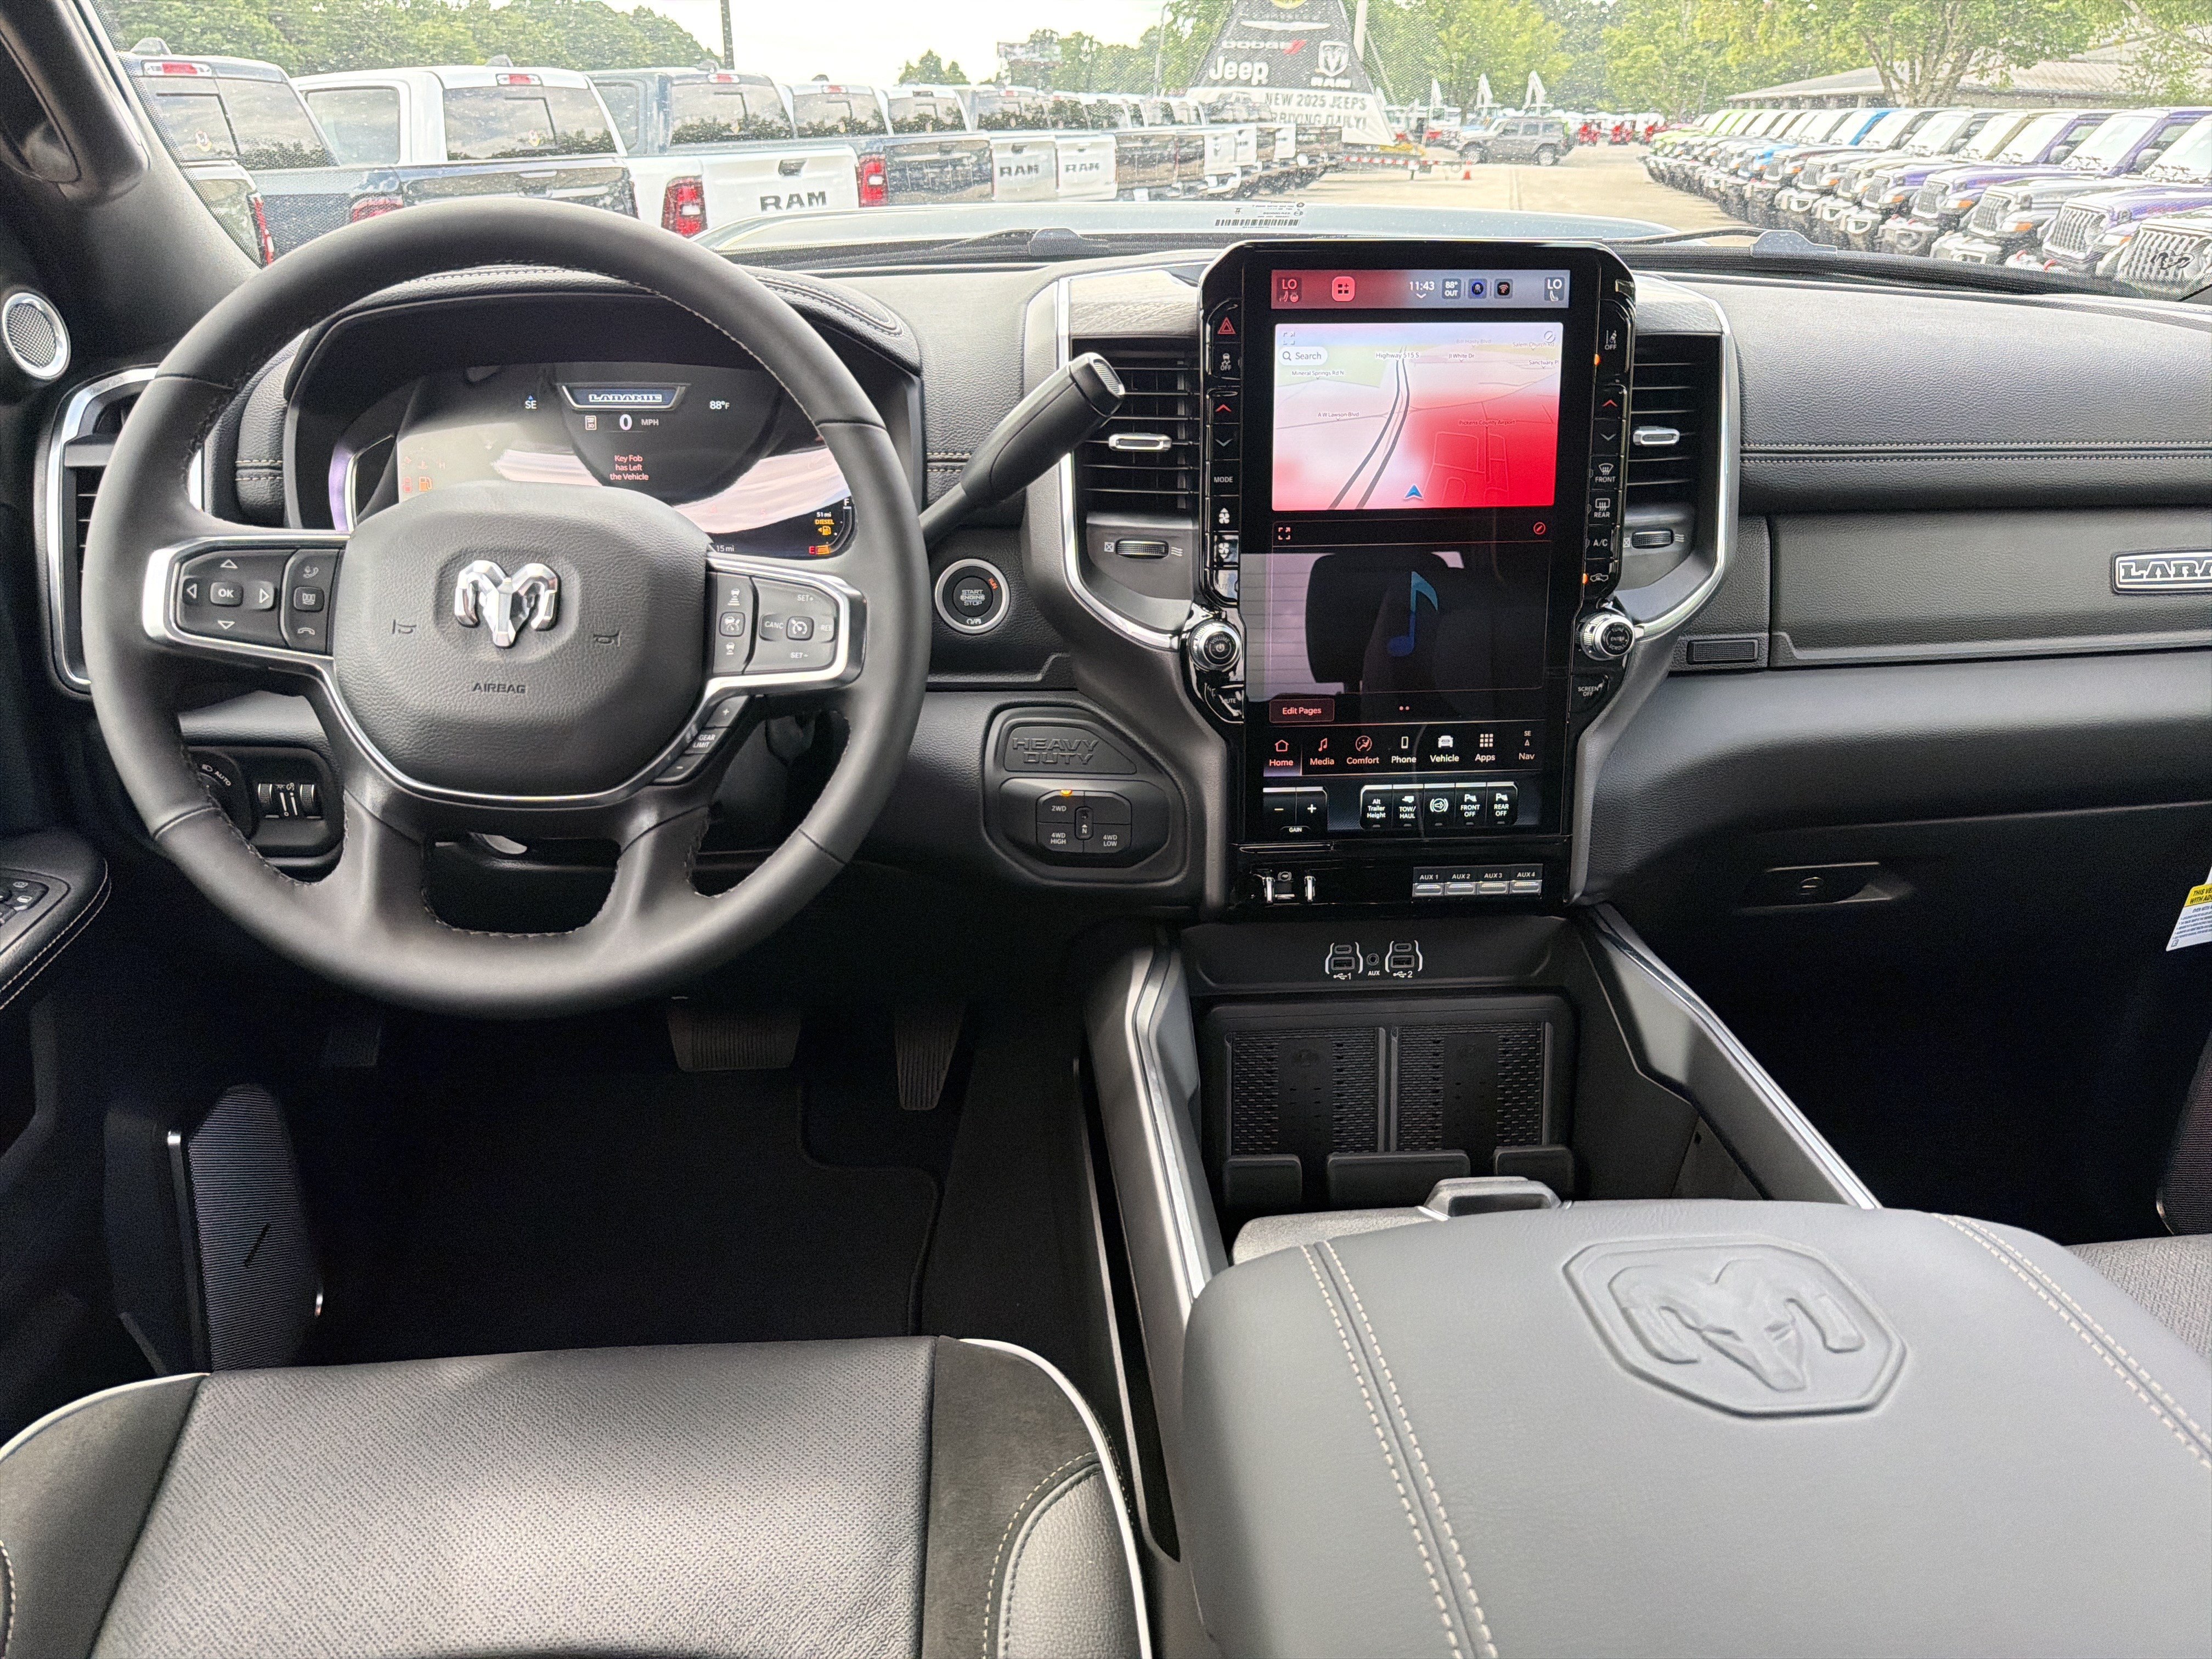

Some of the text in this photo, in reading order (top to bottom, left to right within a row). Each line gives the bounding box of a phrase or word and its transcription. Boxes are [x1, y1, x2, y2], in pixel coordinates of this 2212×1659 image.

[1209, 55, 1269, 85] Jeep
[1265, 92, 1367, 111] NEW 2025 JEEPS
[999, 164, 1040, 177] RAM
[1065, 162, 1099, 173] RAM
[759, 190, 827, 213] RAM
[1282, 279, 1297, 290] LO
[1409, 281, 1435, 291] 11:43
[1547, 279, 1562, 290] LO
[589, 394, 662, 403] LARAMIE
[524, 400, 537, 409] SE
[619, 414, 633, 430] 0
[614, 455, 628, 463] Key
[218, 589, 234, 598] OK
[765, 621, 784, 630] CANC
[472, 682, 526, 693] AIRBAG
[1299, 707, 1322, 716] Pages
[1013, 737, 1099, 752] HEAVY
[1024, 752, 1093, 765] DUTY
[1391, 755, 1417, 764] Phone
[1475, 754, 1496, 763] Apps
[215, 771, 231, 786] AUTO
[2193, 888, 2205, 896] THIS
[2190, 896, 2203, 905] WITH
